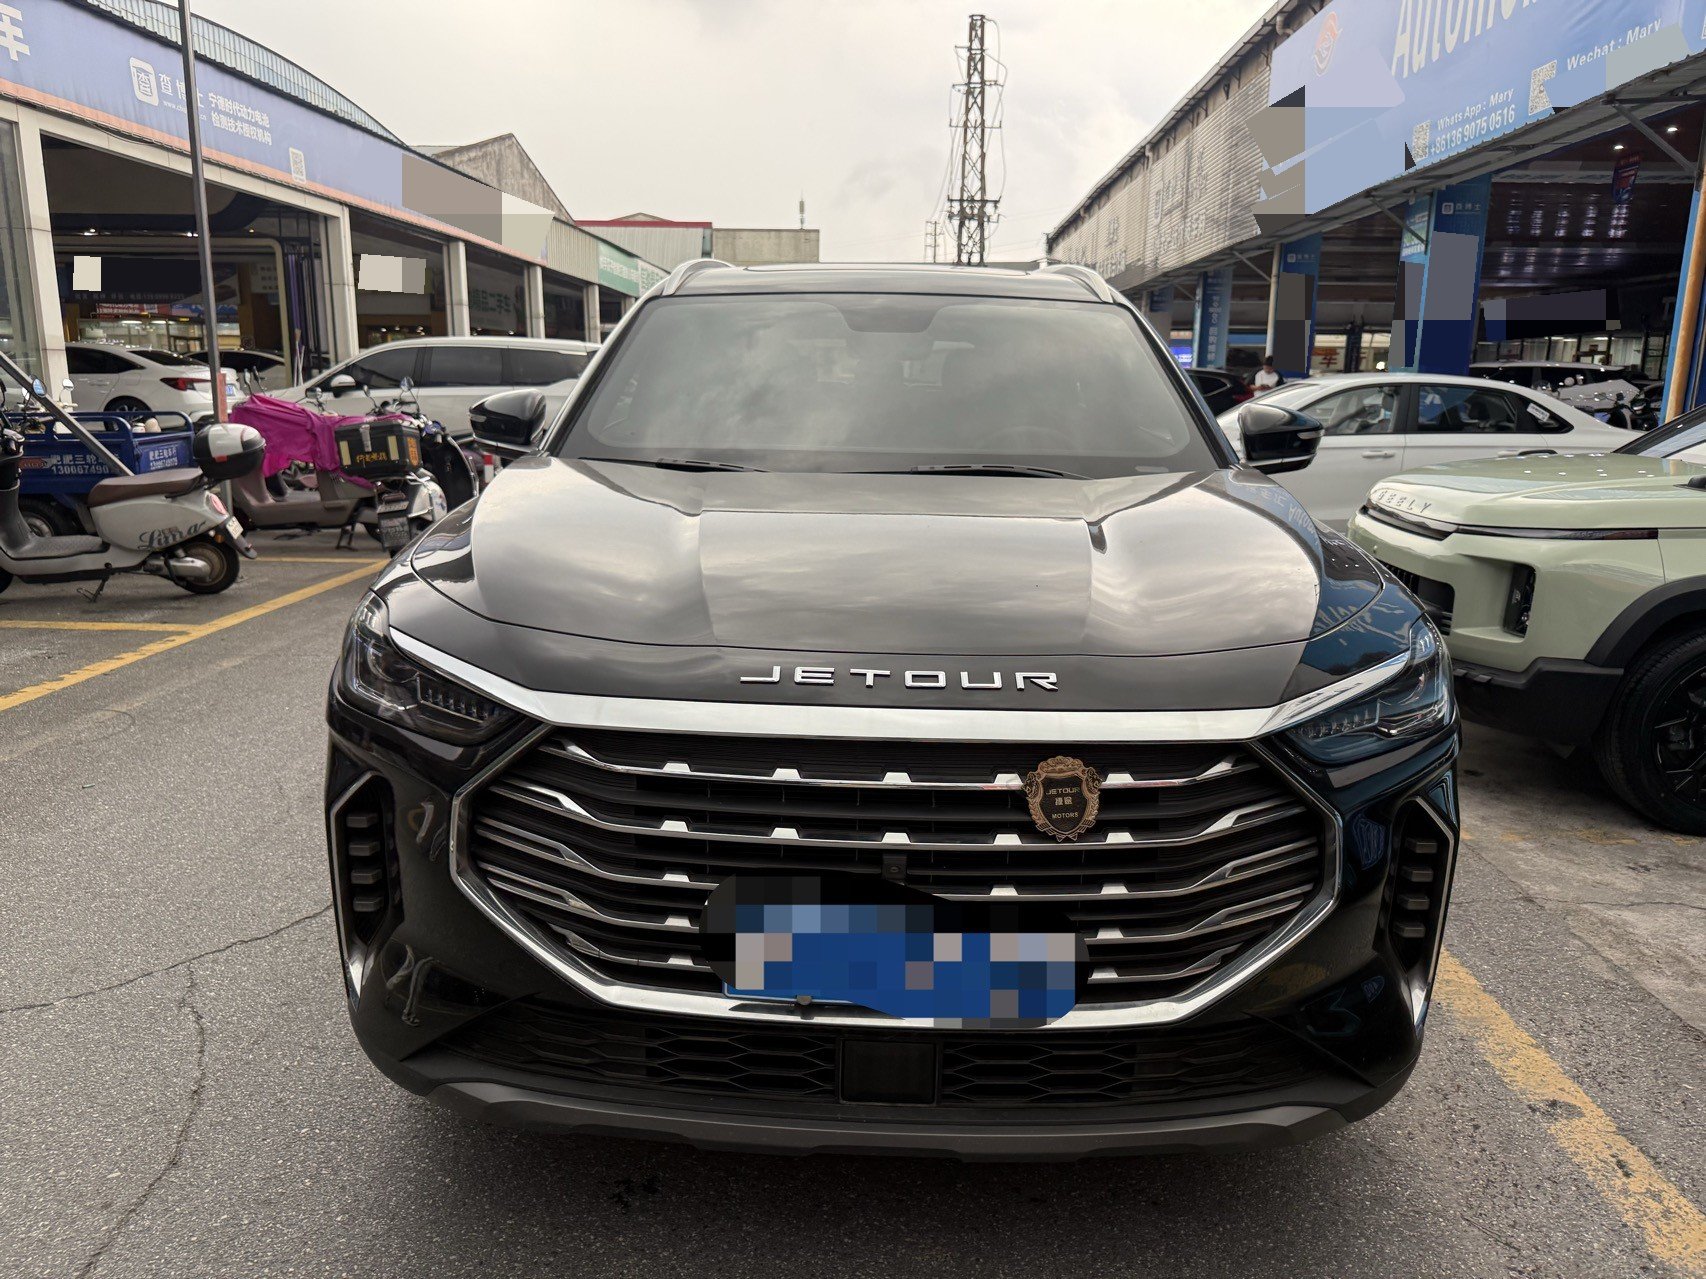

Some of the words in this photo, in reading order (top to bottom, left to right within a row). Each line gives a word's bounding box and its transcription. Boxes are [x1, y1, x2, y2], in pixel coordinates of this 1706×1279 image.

[1489, 88, 1514, 107] Mary
[1463, 116, 1487, 142] 9075
[1489, 104, 1516, 132] 0516
[1378, 490, 1431, 514] GEELY
[740, 665, 1058, 691] JETOUR
[1045, 786, 1080, 795] JETOUR
[1051, 811, 1079, 819] MOTORS
